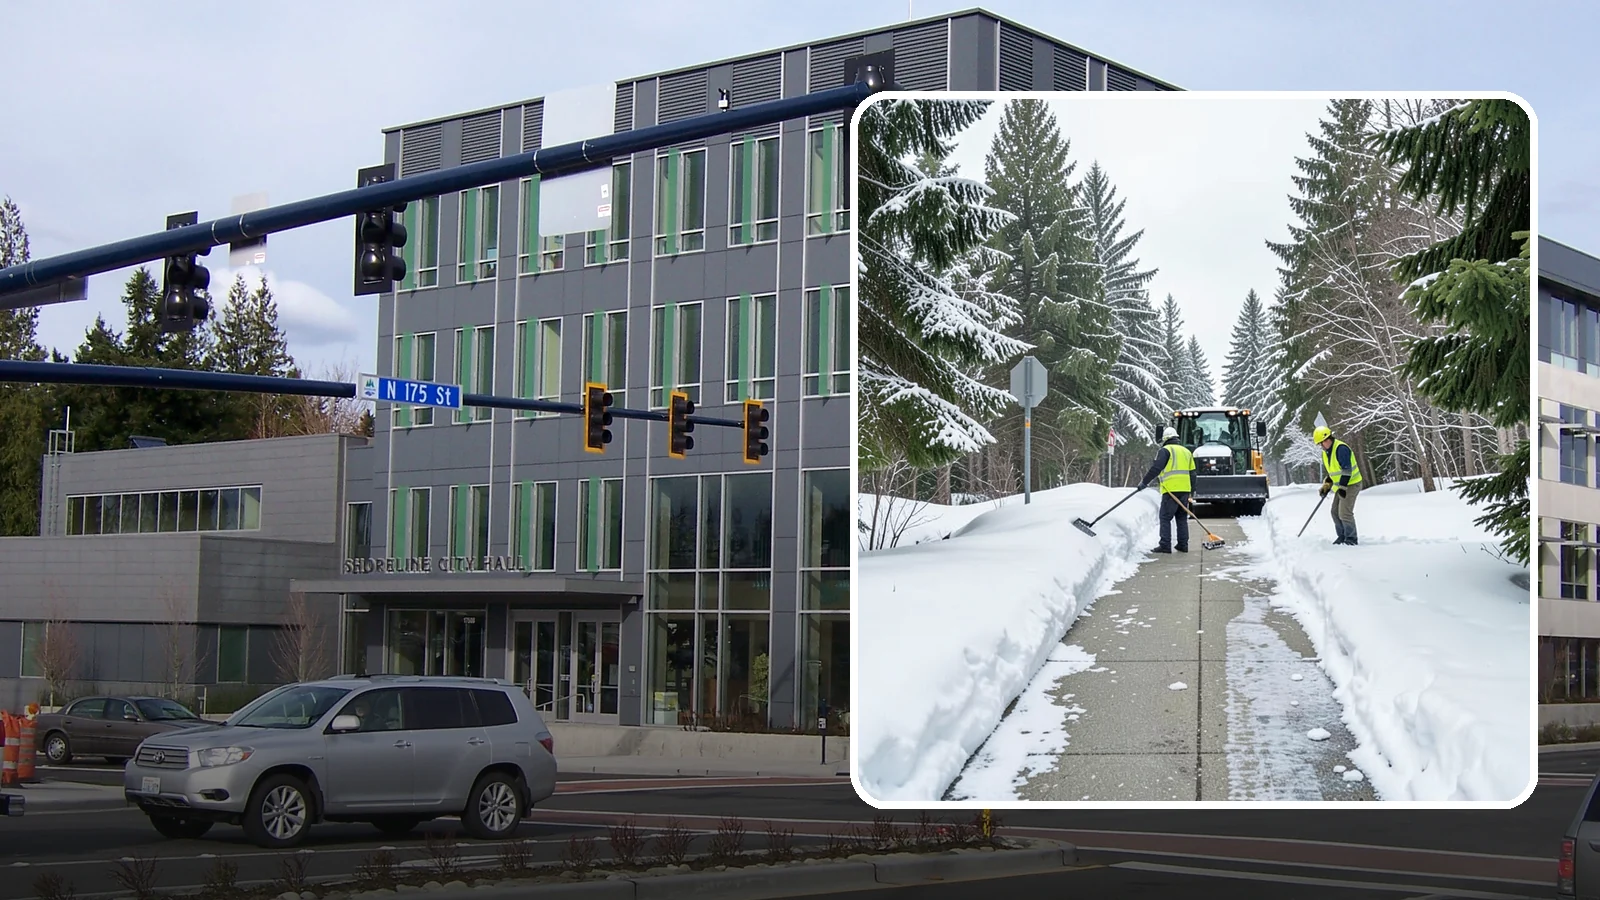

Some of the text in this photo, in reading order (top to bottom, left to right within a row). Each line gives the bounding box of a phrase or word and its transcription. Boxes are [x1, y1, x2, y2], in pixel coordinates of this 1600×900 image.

[387, 380, 451, 406] N 175 St
[343, 555, 526, 574] SHORELINE CITY HALL
